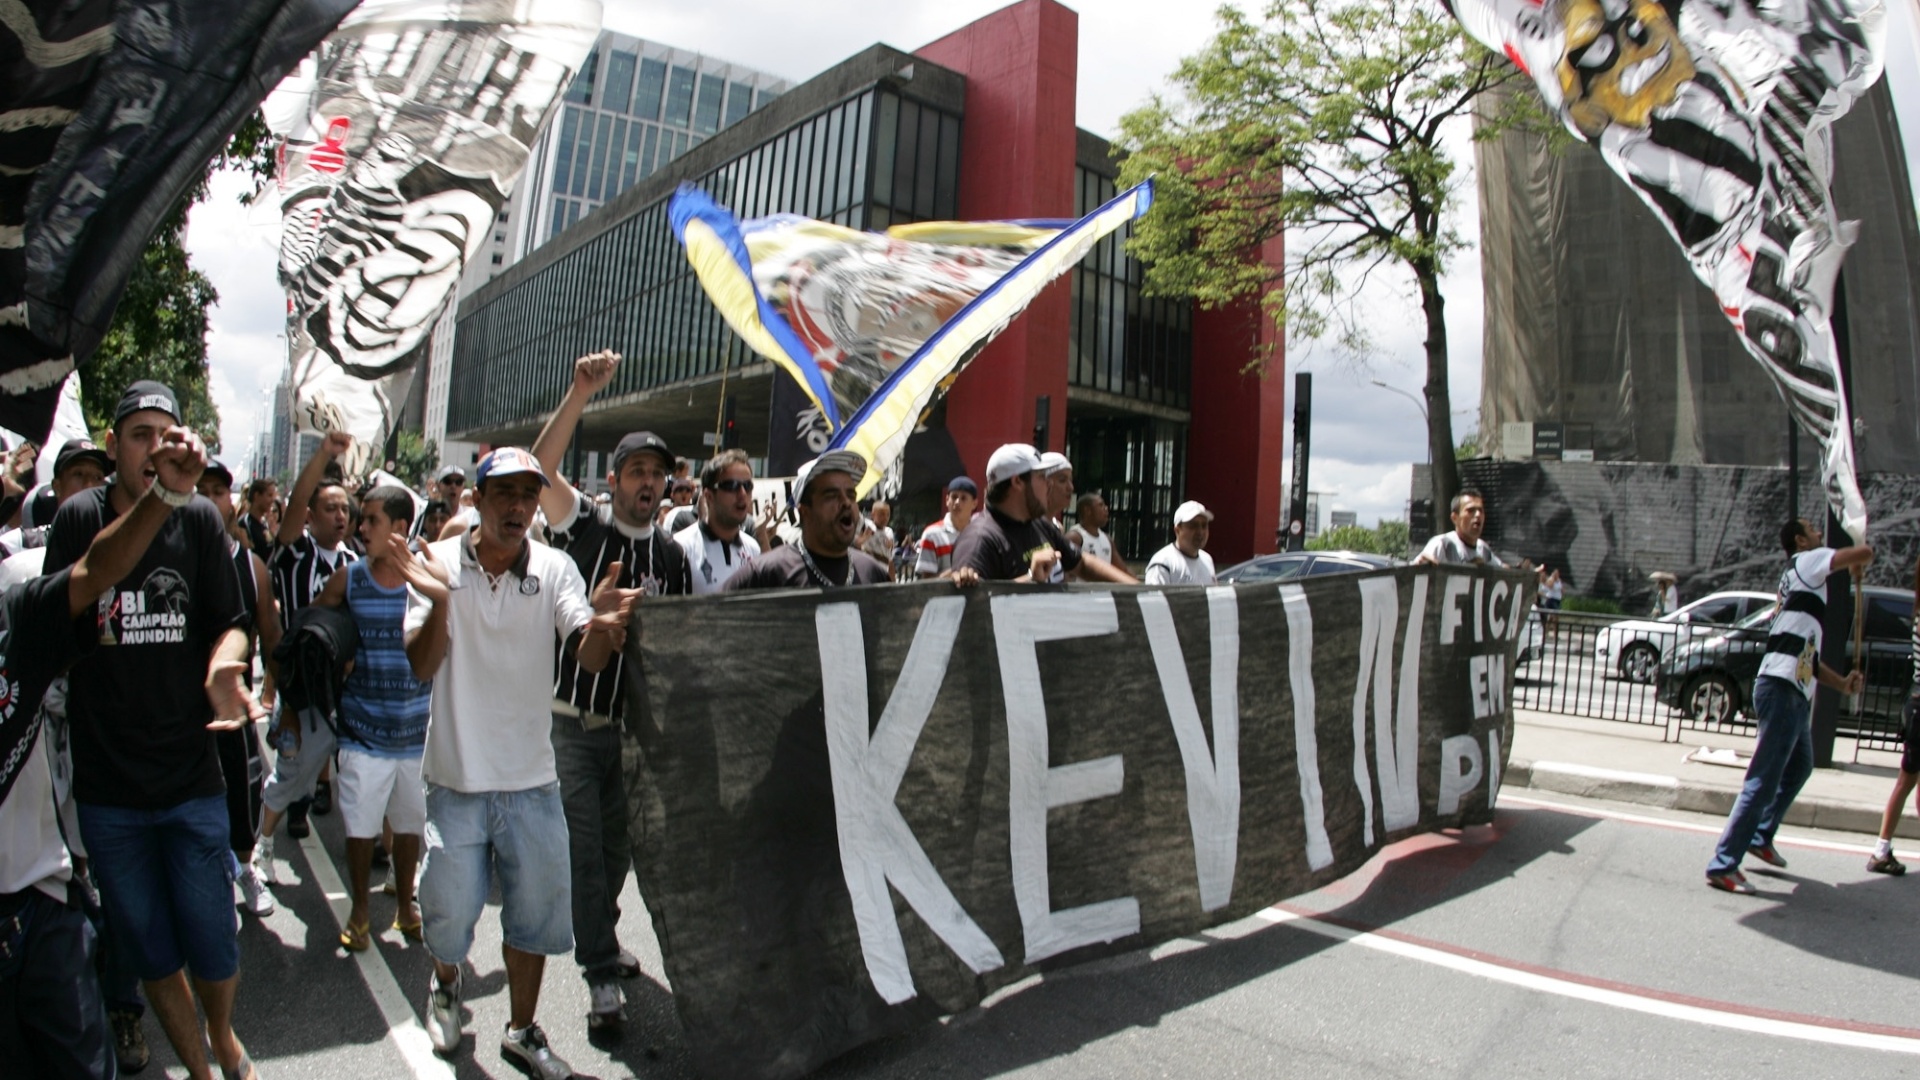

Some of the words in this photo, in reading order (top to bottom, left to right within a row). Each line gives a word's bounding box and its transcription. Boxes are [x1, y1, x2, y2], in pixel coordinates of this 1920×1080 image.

[121, 590, 146, 614] BI
[121, 609, 187, 629] CAMPEÃO
[1439, 574, 1524, 645] FICA
[121, 628, 184, 645] MUNDIAL
[1469, 653, 1506, 720] EM
[815, 573, 1428, 1006] KEVIN
